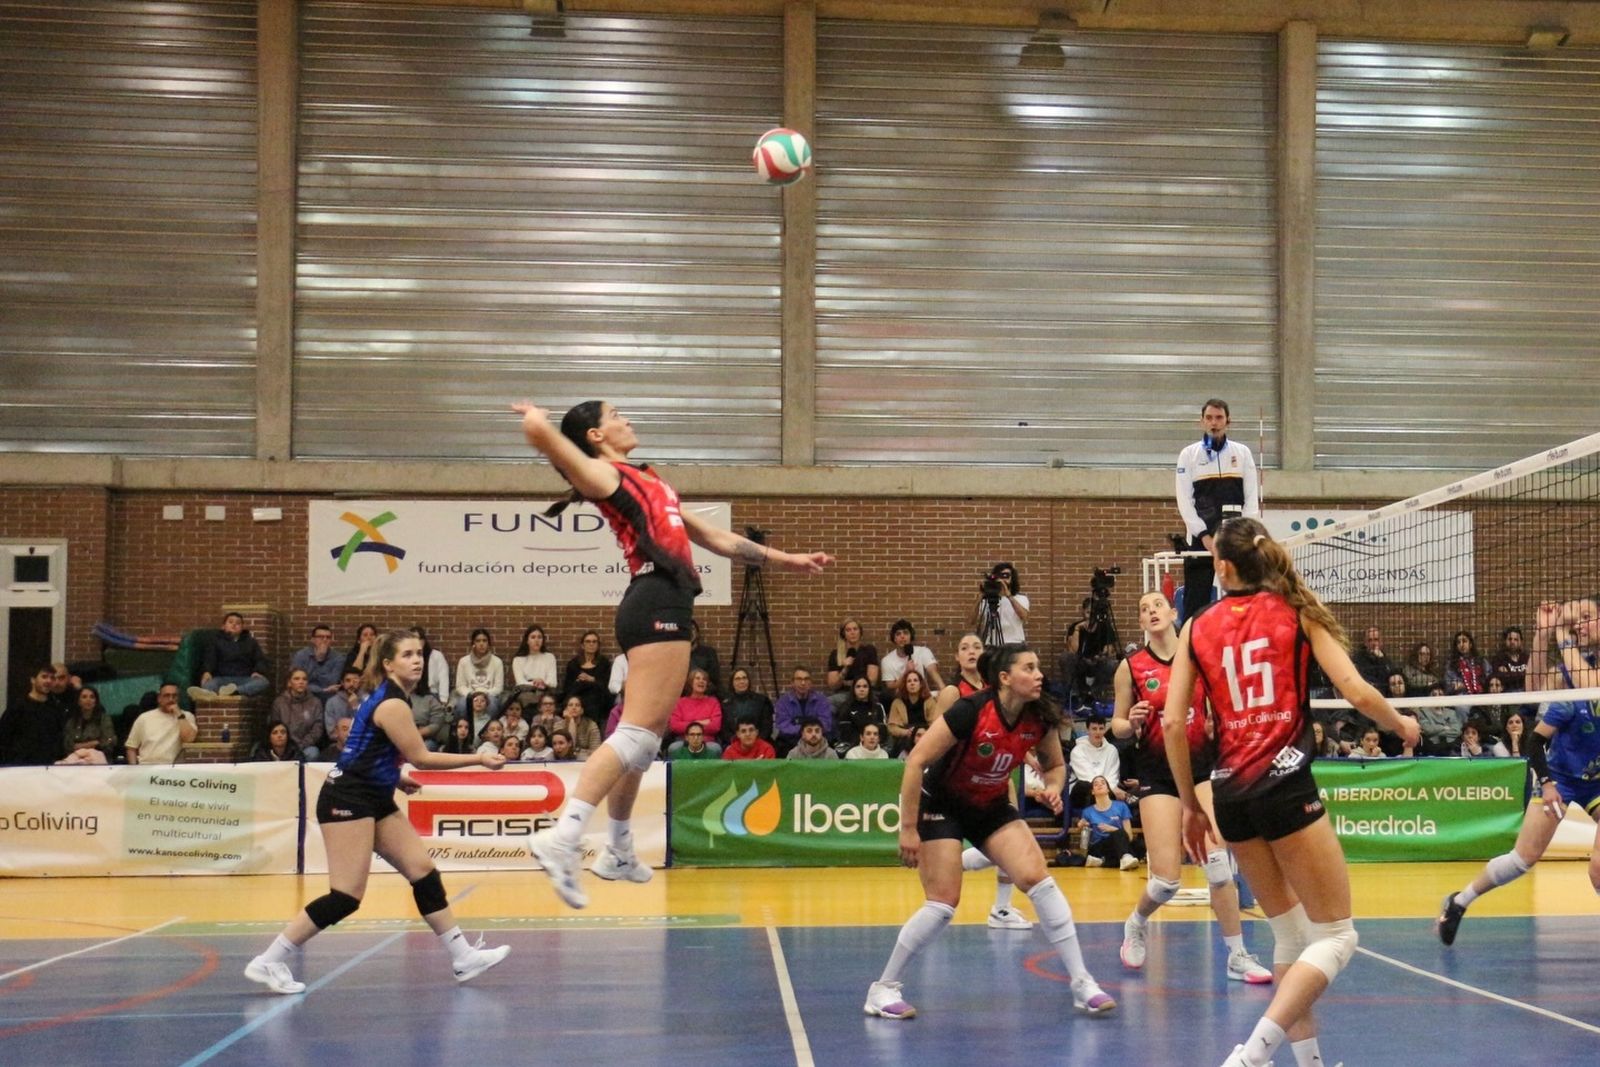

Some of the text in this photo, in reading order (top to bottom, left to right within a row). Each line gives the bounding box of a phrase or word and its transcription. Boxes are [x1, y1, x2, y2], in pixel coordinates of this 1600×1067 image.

[464, 513, 605, 532] FUND
[418, 561, 712, 576] fundación deporte alcas
[1329, 569, 1426, 581] ALCOBENDAS
[1222, 637, 1275, 712] 15
[992, 753, 1014, 772] 10
[150, 775, 237, 793] Kanso Coliving
[1334, 787, 1428, 801] IBERDROLA
[1433, 786, 1514, 801] VOLEIBOL
[150, 797, 231, 812] El valor de vivir
[137, 812, 240, 827] en una comunidad
[793, 793, 901, 834] Iberd
[15, 811, 98, 835] Coliving
[1336, 815, 1436, 836] Iberdrola
[152, 828, 223, 841] multicultural
[128, 846, 242, 862] www.kansocoliving.com
[454, 847, 526, 859] instalando
